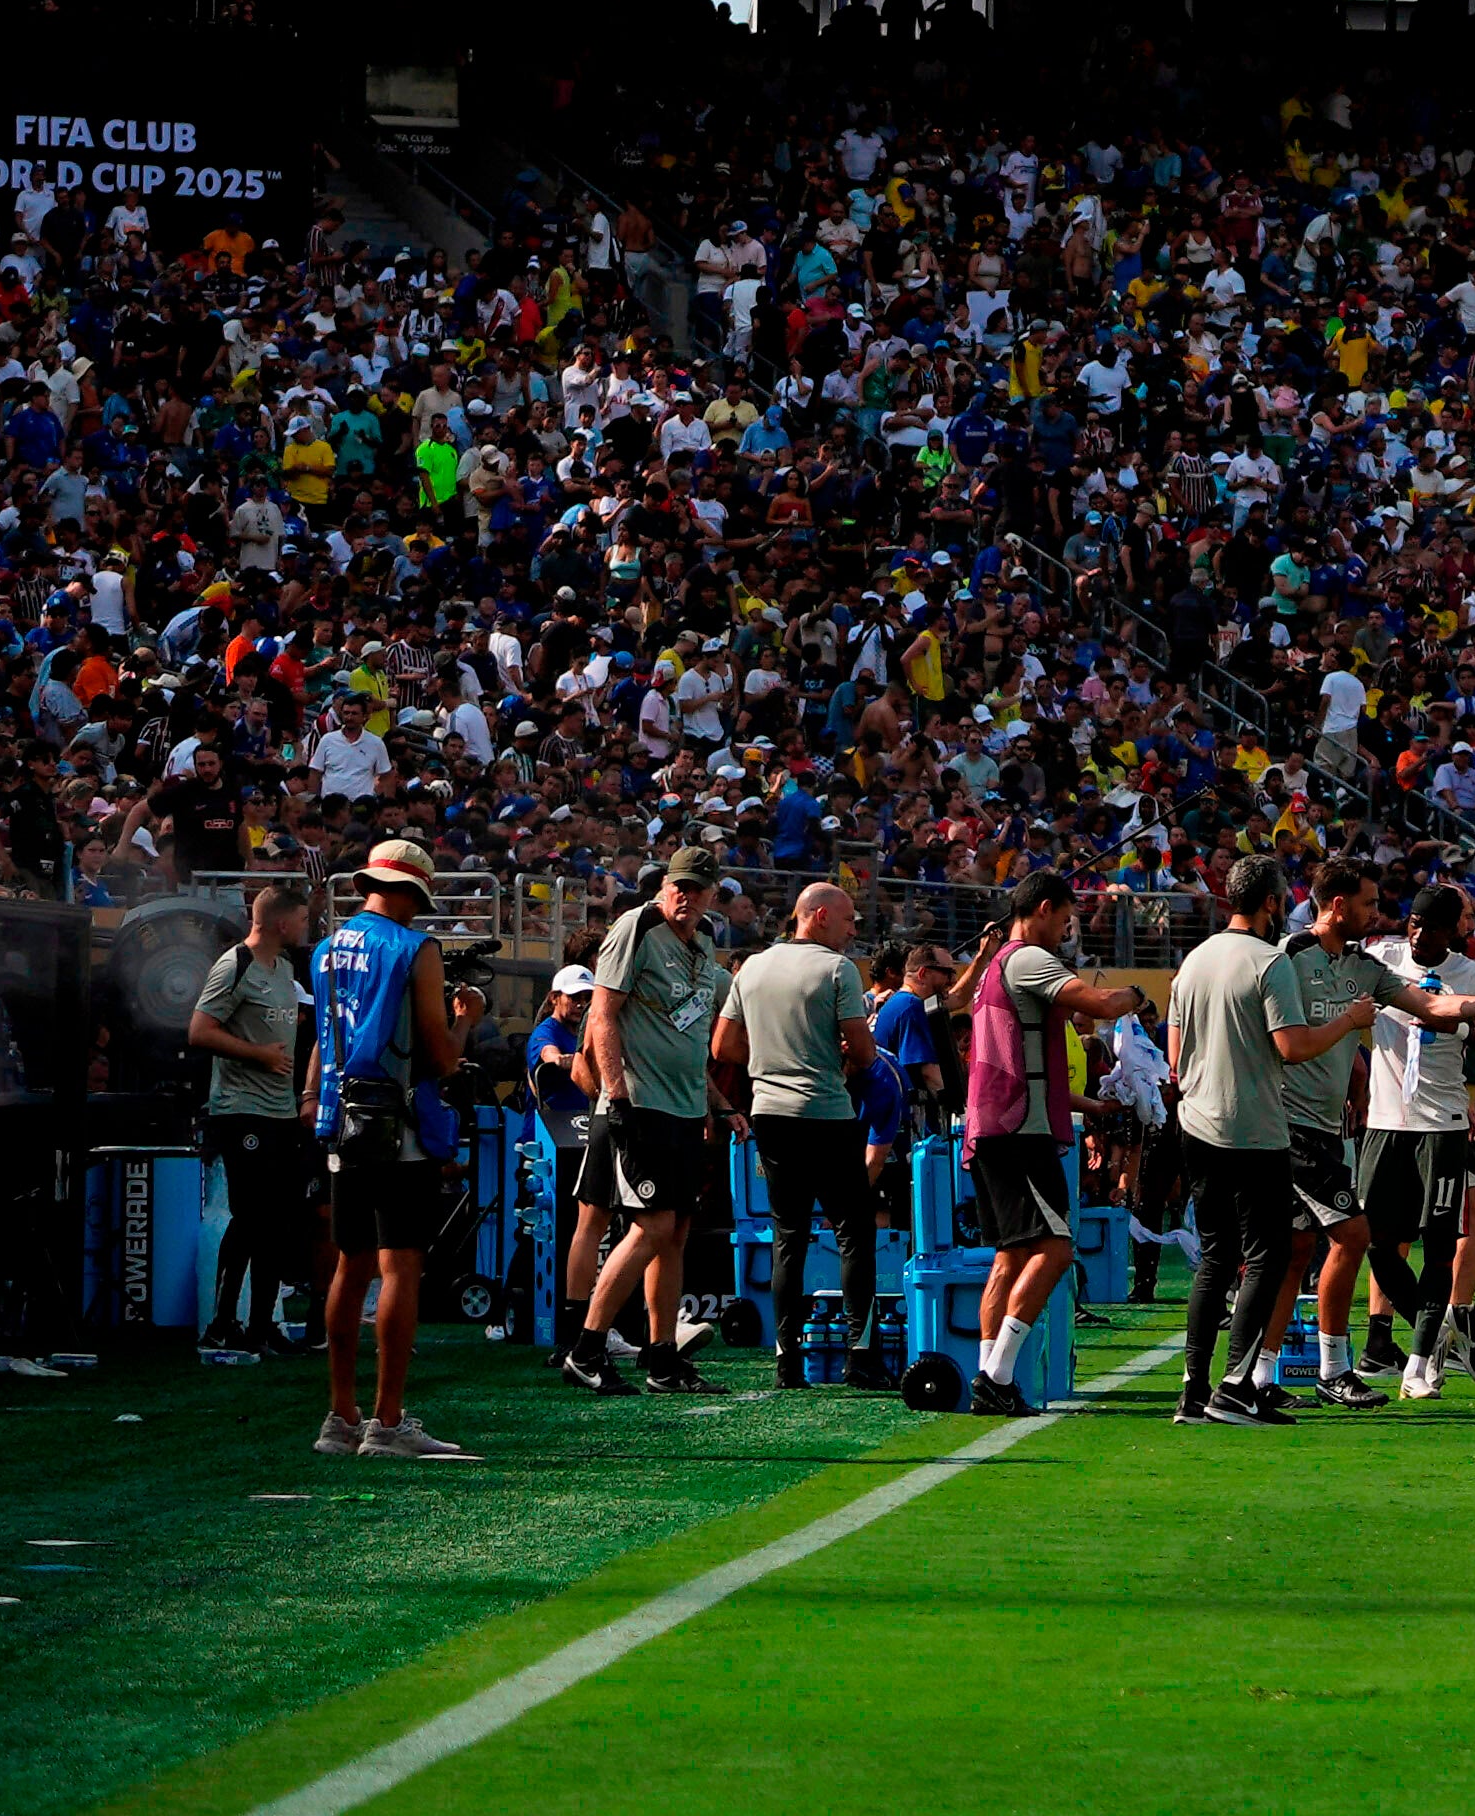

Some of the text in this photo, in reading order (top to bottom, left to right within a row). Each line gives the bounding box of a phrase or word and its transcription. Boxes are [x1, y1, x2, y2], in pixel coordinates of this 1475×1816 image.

[15, 115, 197, 153] FIFA CLUB
[91, 161, 167, 195] CUP
[1435, 1177, 1455, 1208] 11
[680, 1293, 736, 1319] 025
[1285, 1366, 1320, 1376] POWER
